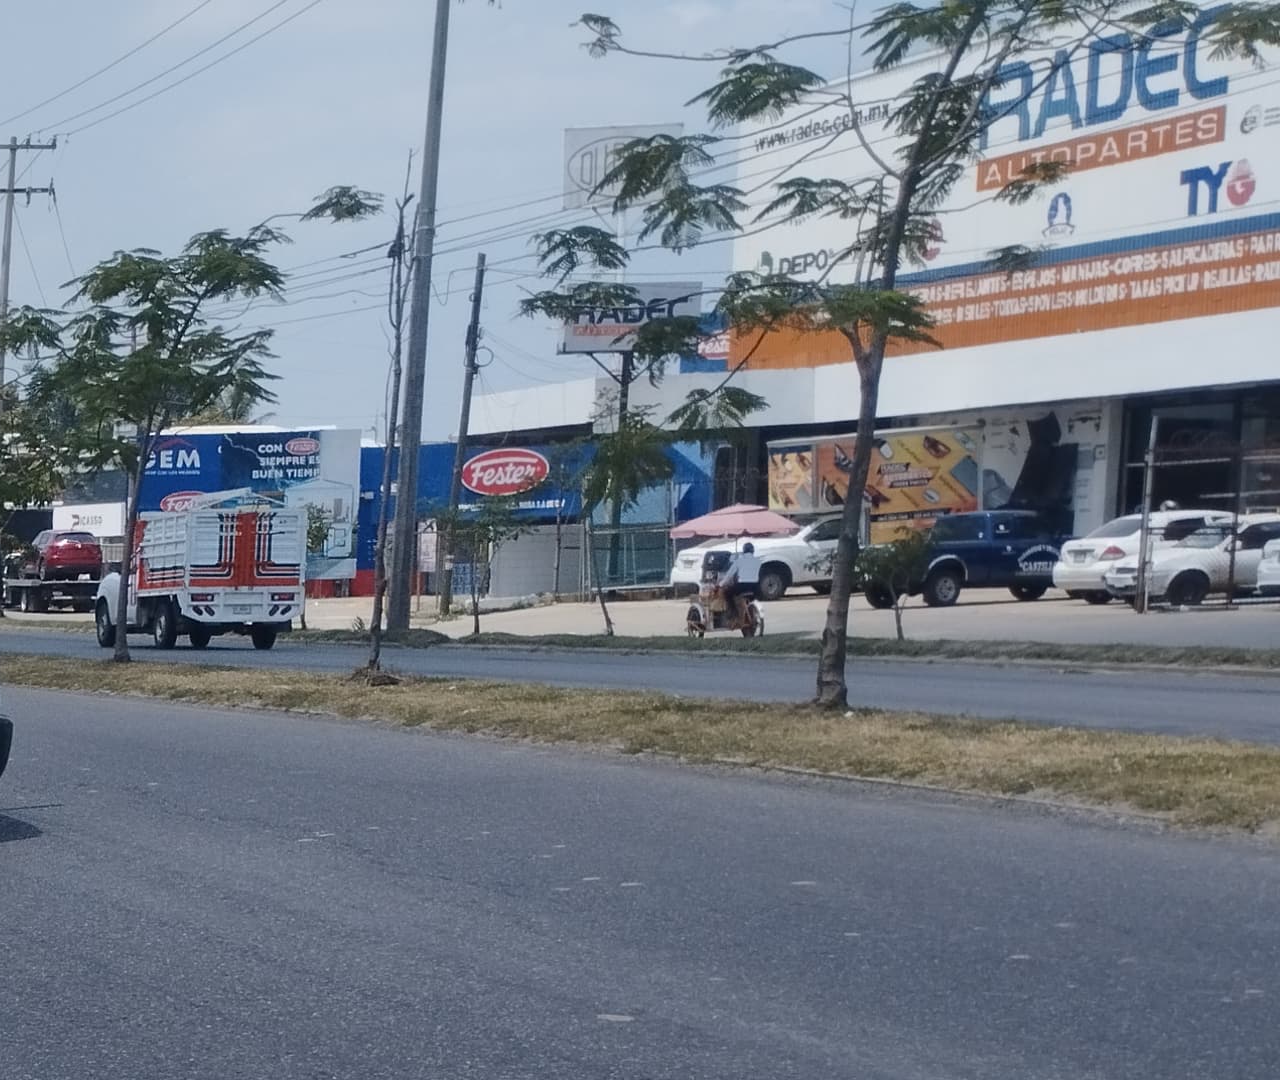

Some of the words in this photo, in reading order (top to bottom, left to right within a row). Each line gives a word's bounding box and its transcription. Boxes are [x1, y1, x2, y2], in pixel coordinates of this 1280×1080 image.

[979, 2, 1233, 150] RADEC
[779, 250, 828, 276] DEPO
[258, 443, 283, 454] CON
[260, 455, 306, 466] SIEMPRE
[252, 469, 283, 479] BUEN
[286, 468, 320, 478] TIEMP
[470, 456, 539, 488] Fester
